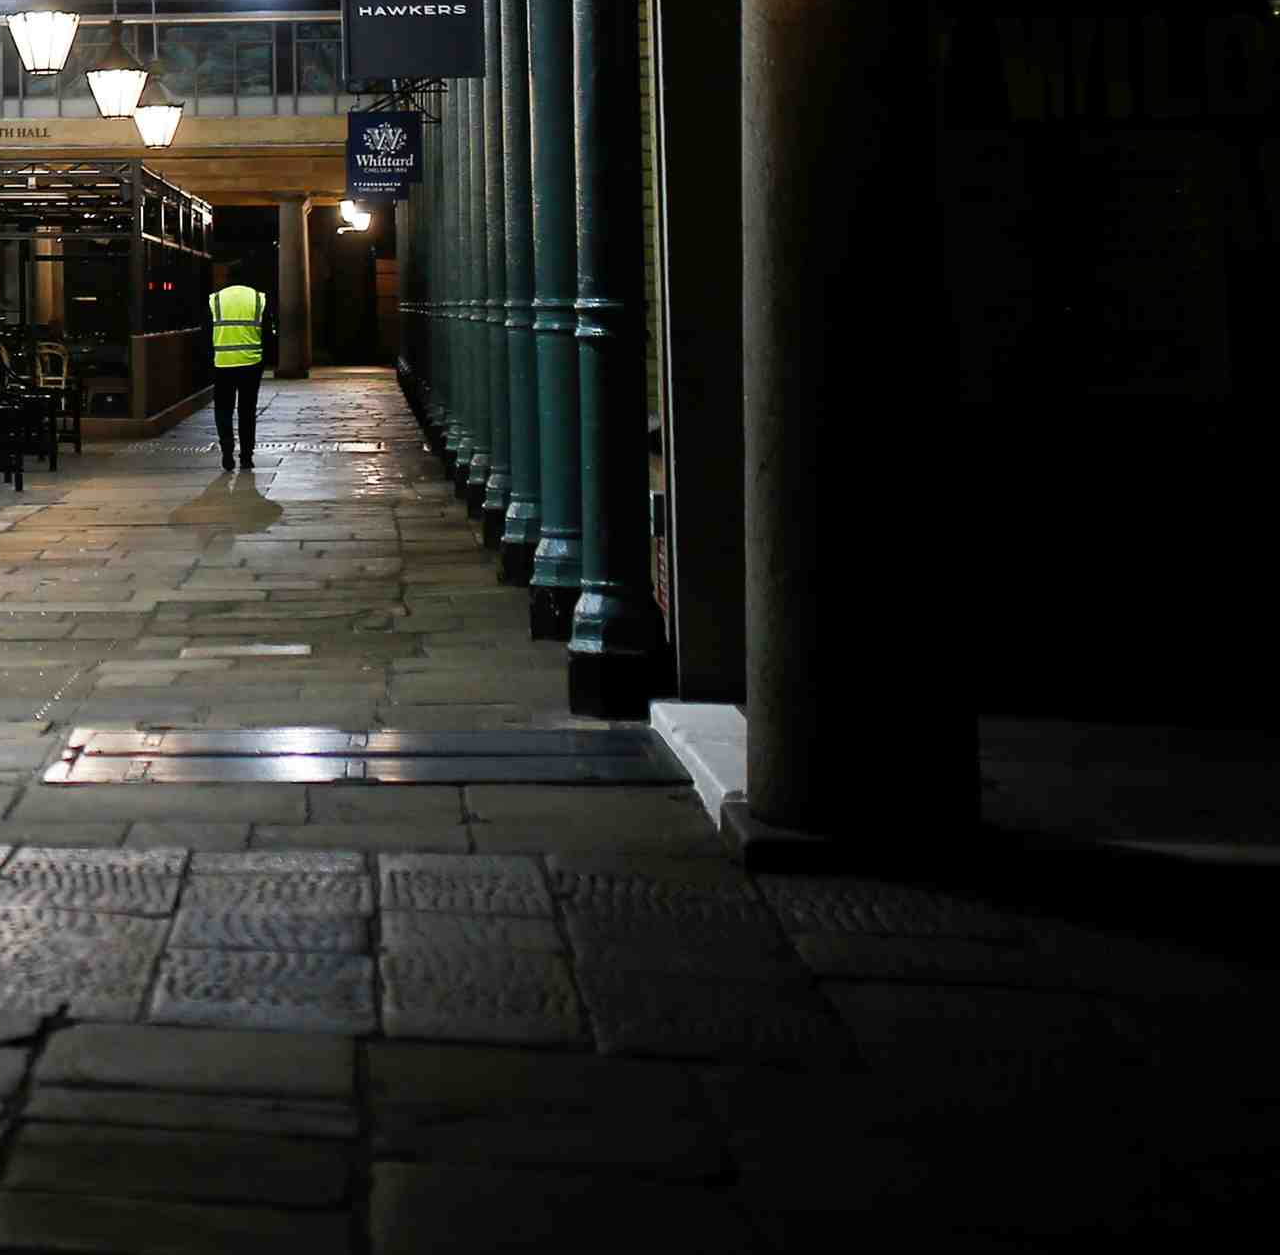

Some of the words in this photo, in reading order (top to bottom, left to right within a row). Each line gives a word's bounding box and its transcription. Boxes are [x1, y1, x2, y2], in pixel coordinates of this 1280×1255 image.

[359, 4, 468, 17] HAWKERS
[16, 127, 52, 138] HALL
[355, 153, 415, 167] Whittard
